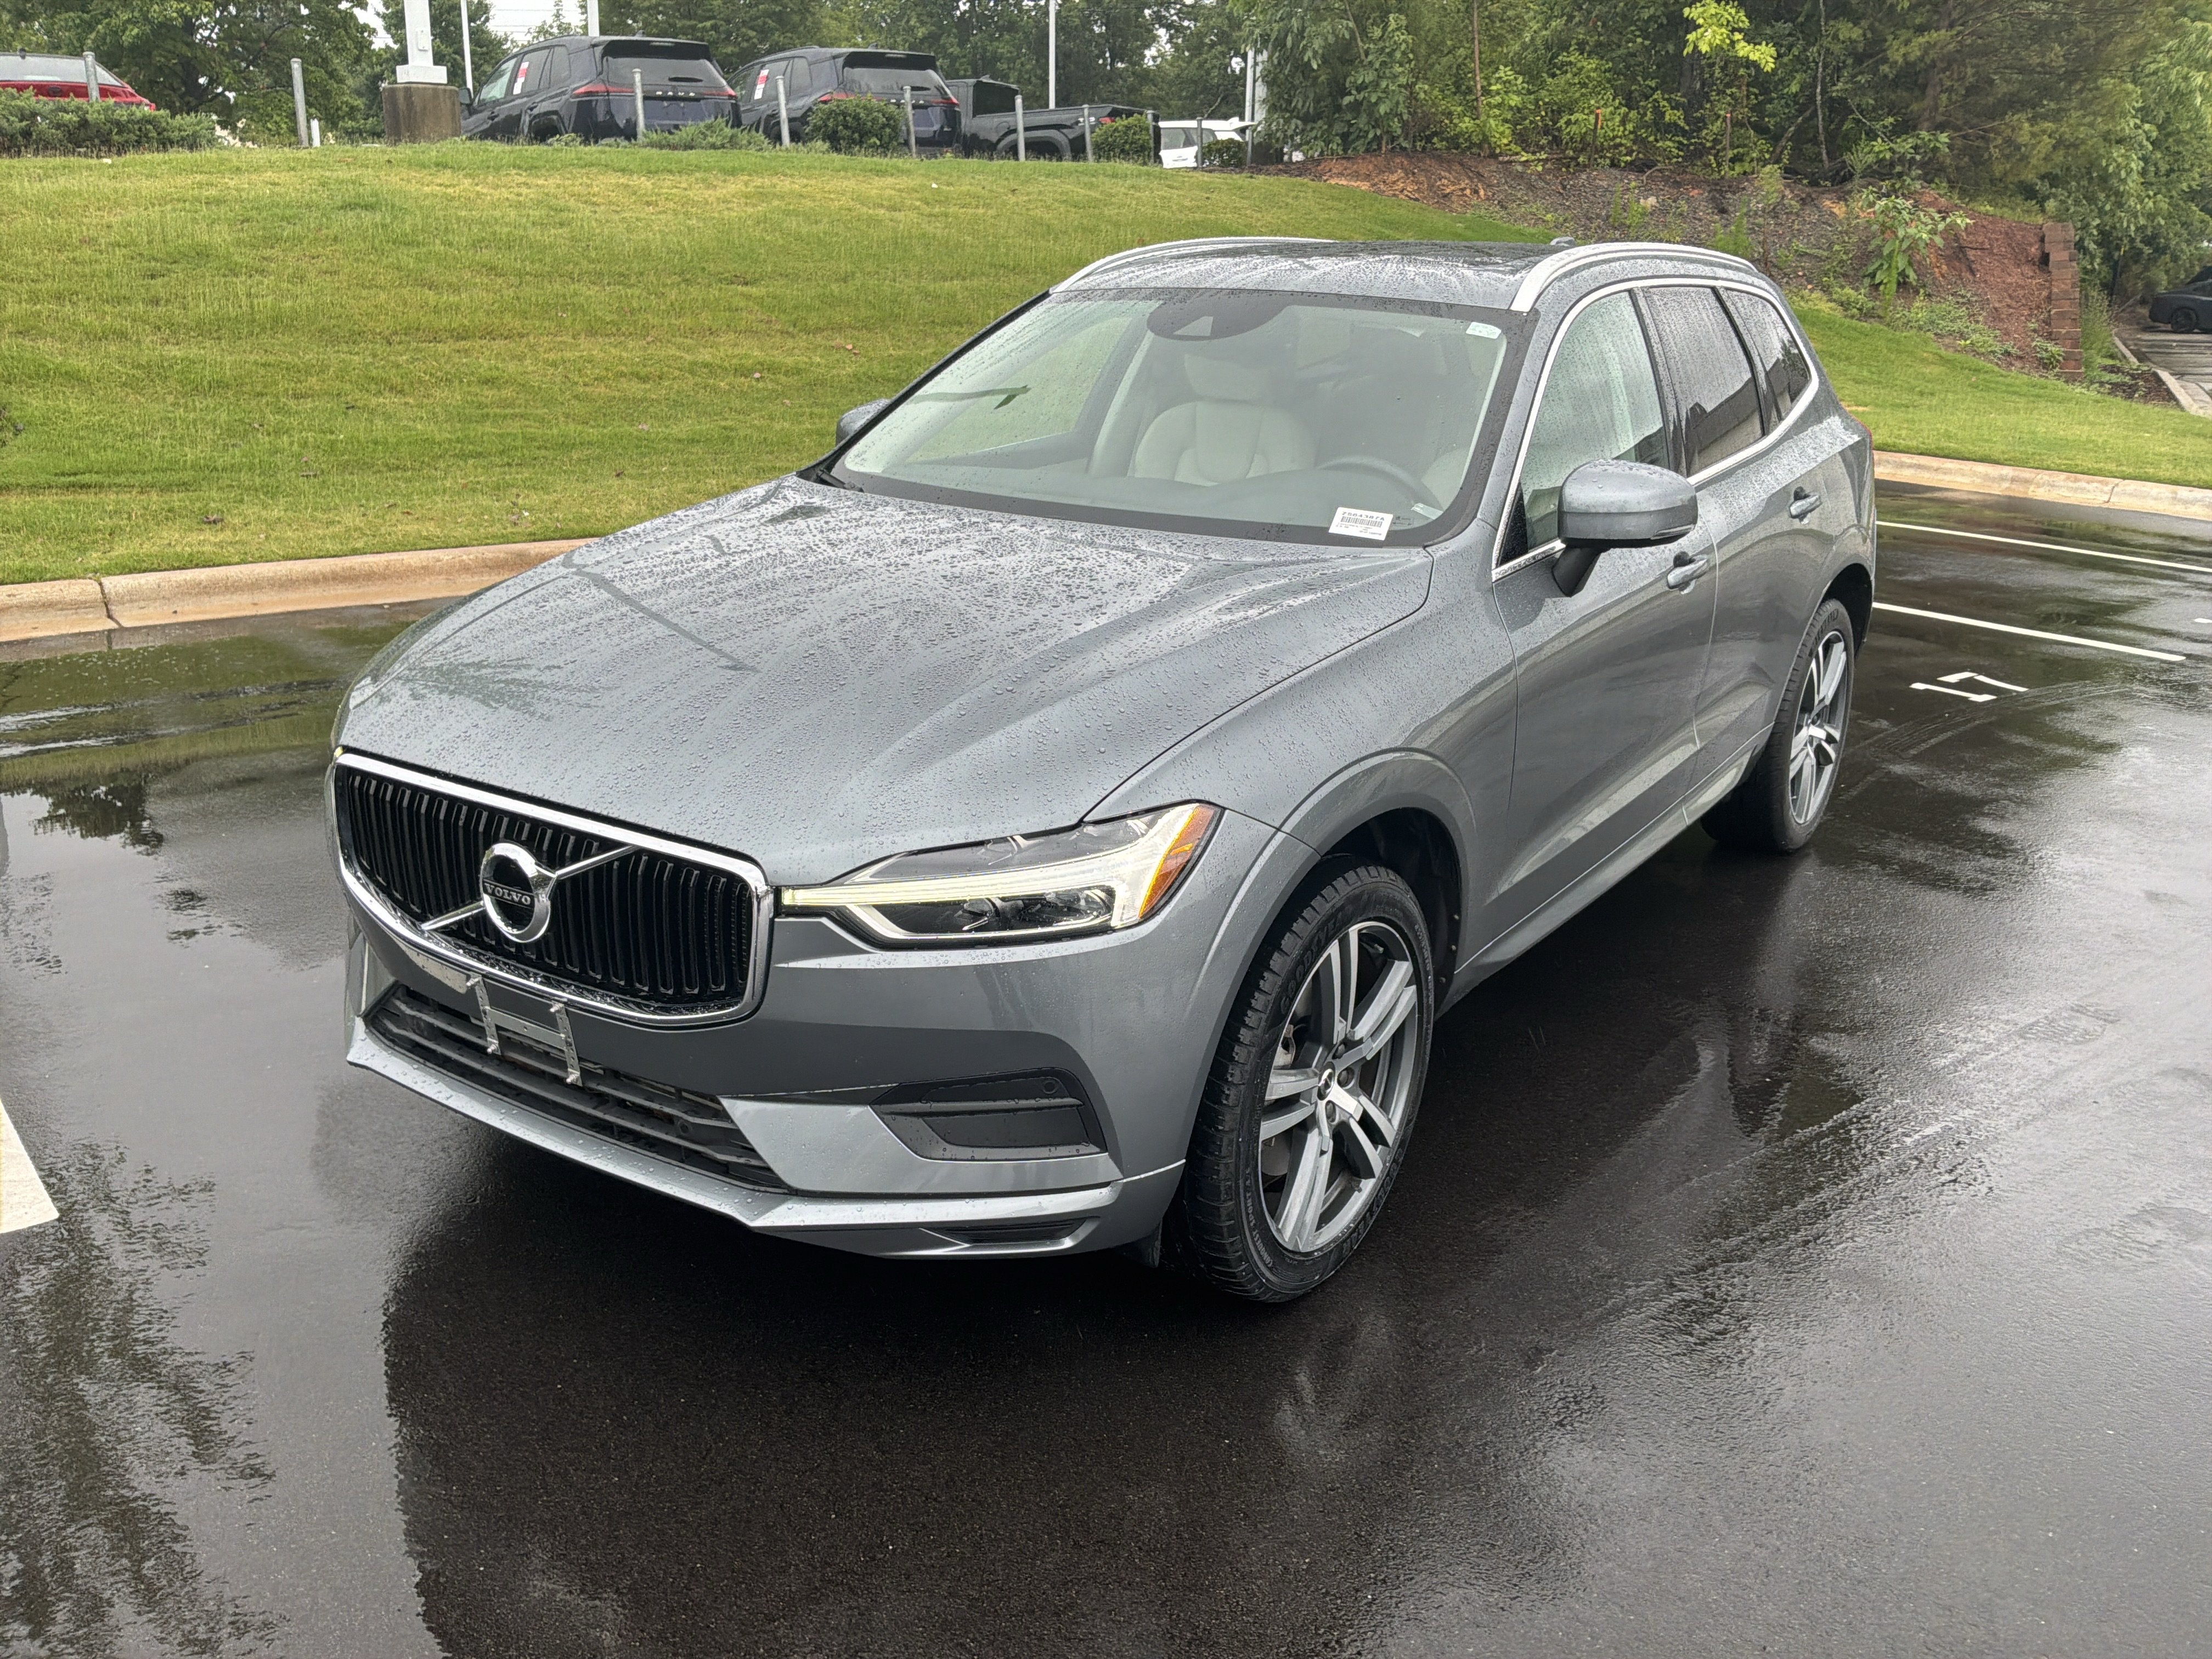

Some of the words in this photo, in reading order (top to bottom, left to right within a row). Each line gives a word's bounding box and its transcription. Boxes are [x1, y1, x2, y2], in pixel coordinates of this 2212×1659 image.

[484, 883, 531, 905] VOLVO
[1246, 1191, 1256, 1227] SPORT
[1252, 1229, 1273, 1267] CONQUEST
